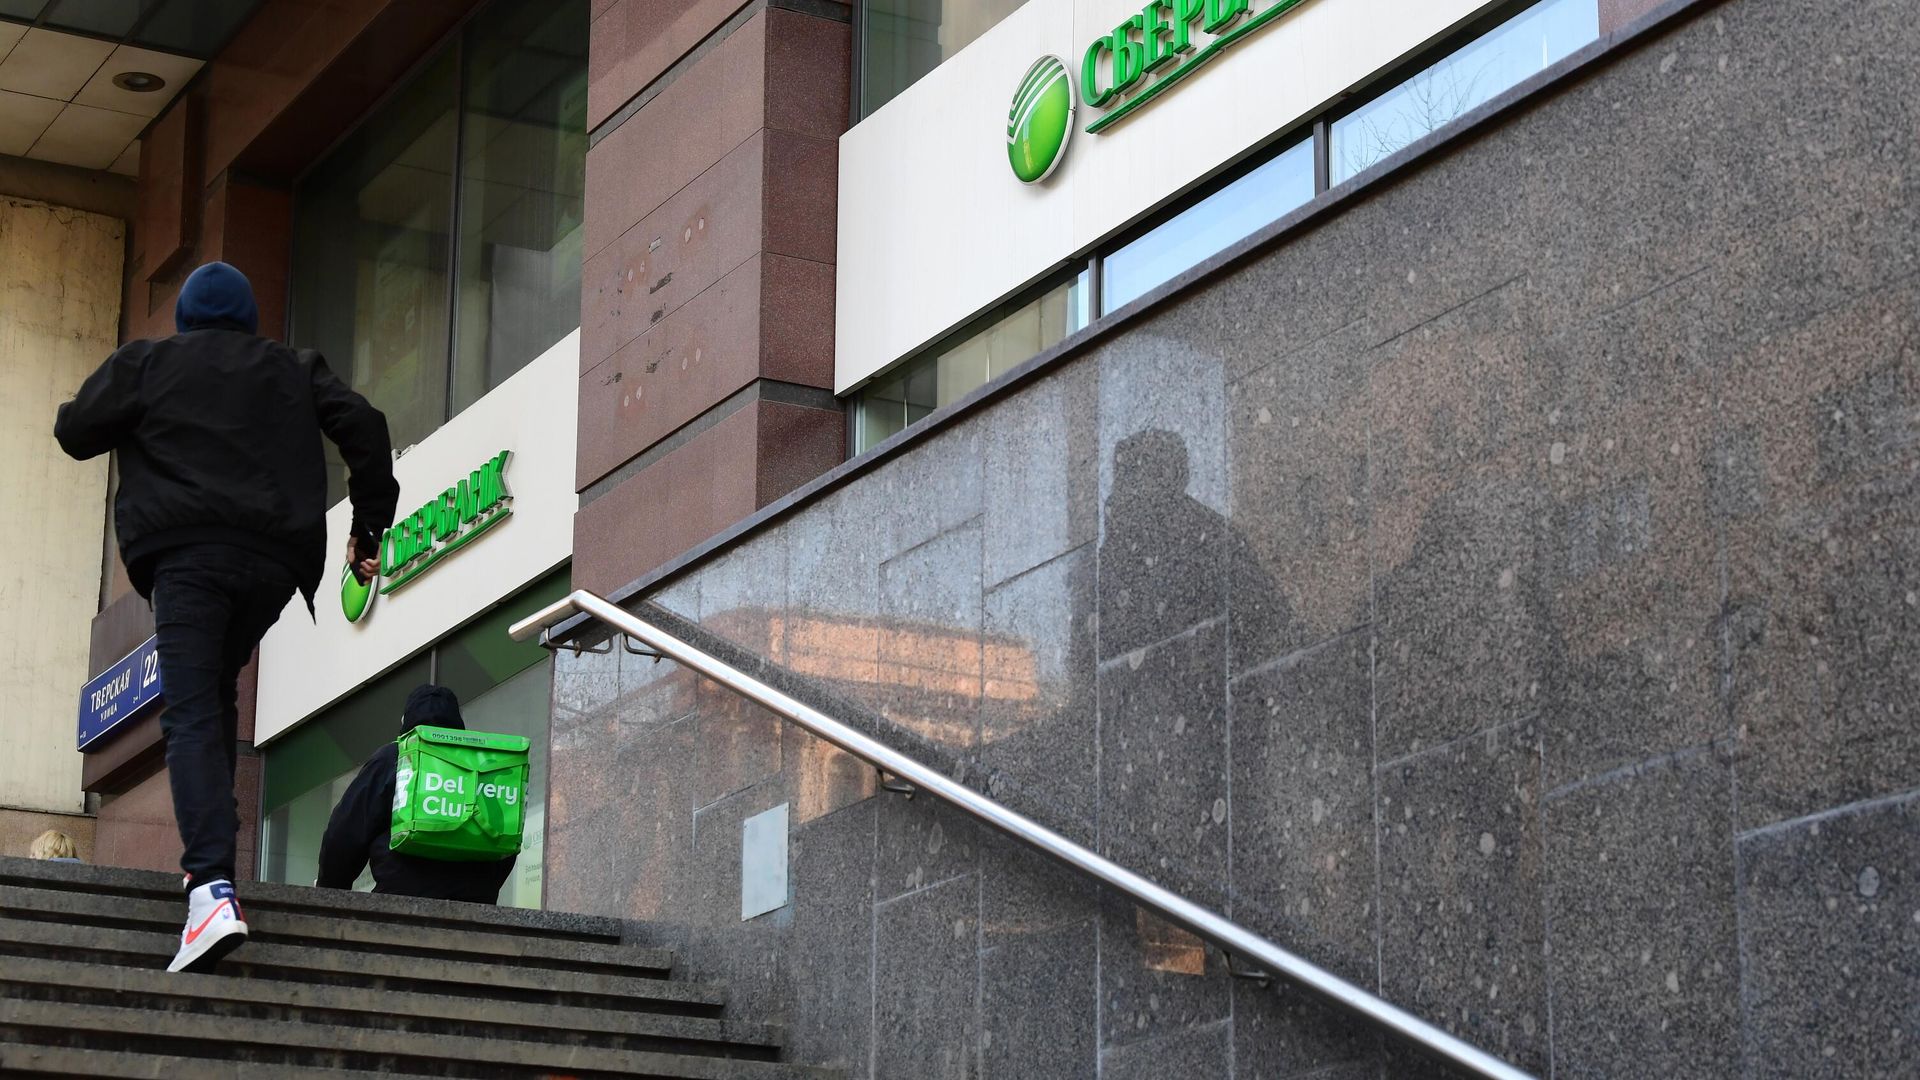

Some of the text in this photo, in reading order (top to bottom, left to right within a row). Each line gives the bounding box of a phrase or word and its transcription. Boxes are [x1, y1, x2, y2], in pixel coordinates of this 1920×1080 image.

[380, 450, 514, 578] СБЕРБАНК
[90, 668, 131, 713] ТВЕРСКАЯ
[100, 702, 118, 722] УЛИЦА
[424, 772, 518, 806] Delvery
[422, 795, 468, 819] Clu
